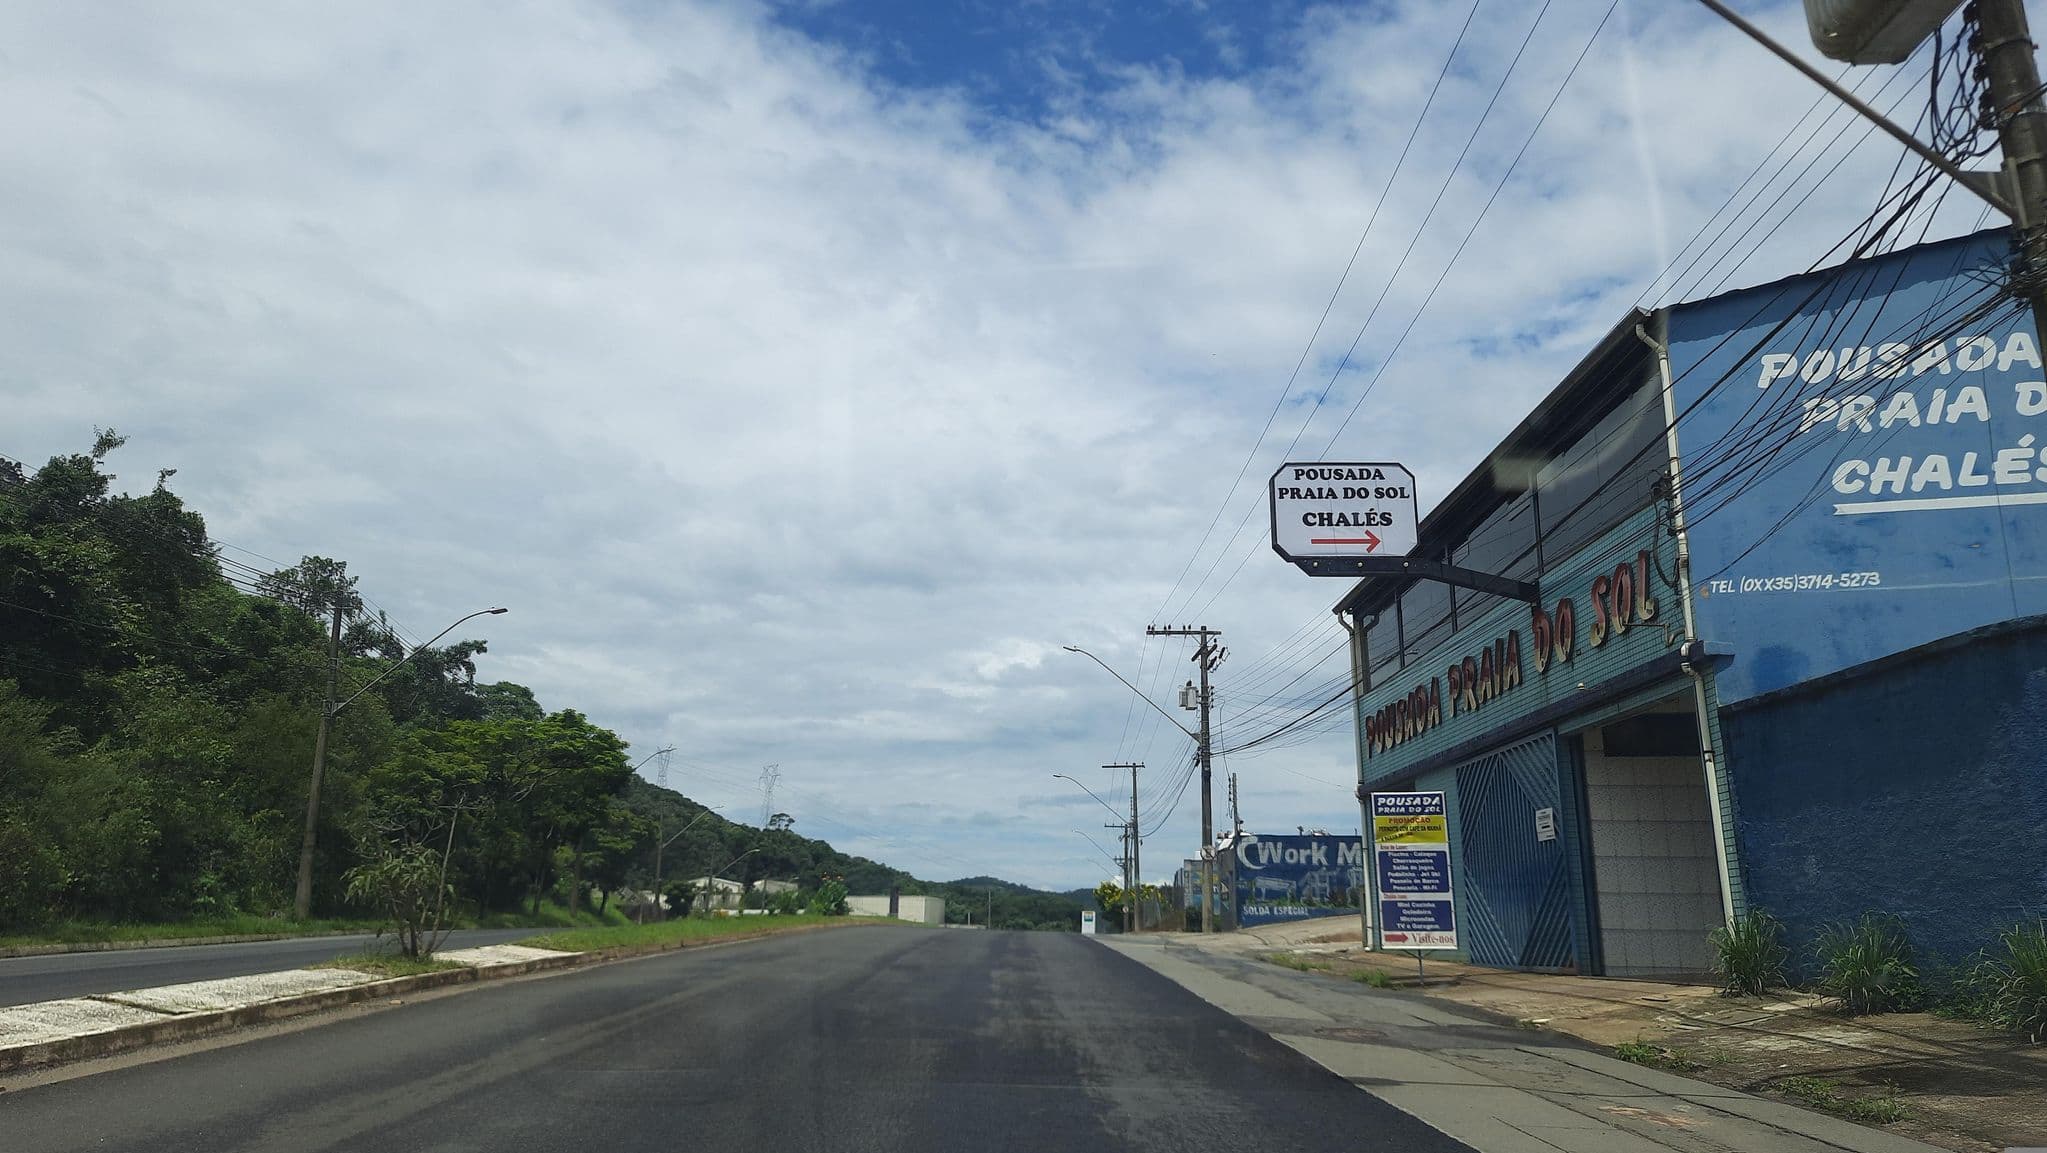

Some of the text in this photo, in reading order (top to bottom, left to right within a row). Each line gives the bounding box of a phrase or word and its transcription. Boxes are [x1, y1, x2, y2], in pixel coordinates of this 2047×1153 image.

[1757, 332, 2042, 389] POUSADA
[1798, 386, 1992, 434] PRAIA
[1294, 468, 1385, 481] POUSADA
[1278, 486, 1410, 500] PRAIA DO SOL
[1302, 508, 1393, 527] CHALÉS
[1710, 580, 1735, 594] TEL
[1365, 549, 1659, 760] POUSADA PRAIA DO SOL
[1377, 796, 1440, 806] POUSADA
[1243, 906, 1270, 916] SOLDA
[1411, 933, 1455, 944] Visite-nos
